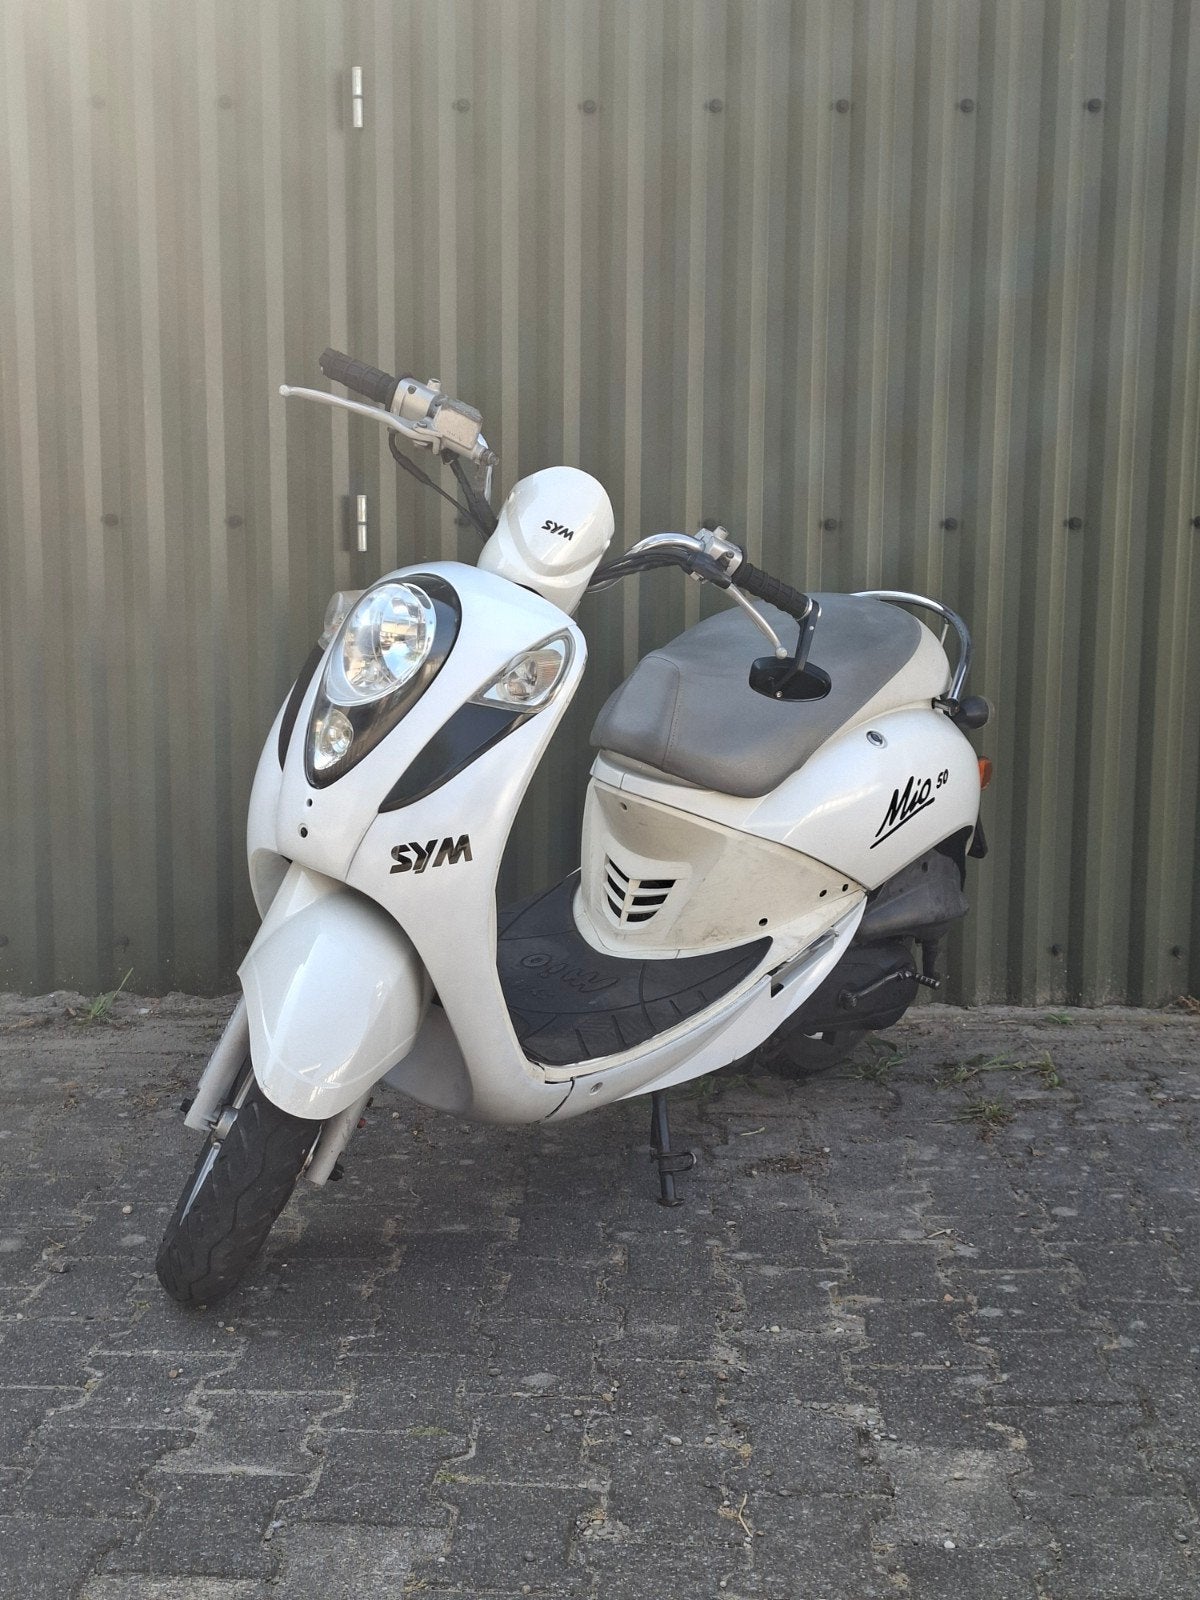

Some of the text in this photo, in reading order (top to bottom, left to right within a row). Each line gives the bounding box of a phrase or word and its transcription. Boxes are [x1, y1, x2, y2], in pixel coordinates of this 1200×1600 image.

[541, 519, 574, 541] SYM
[873, 768, 949, 840] Mio 50
[390, 833, 473, 874] SYM
